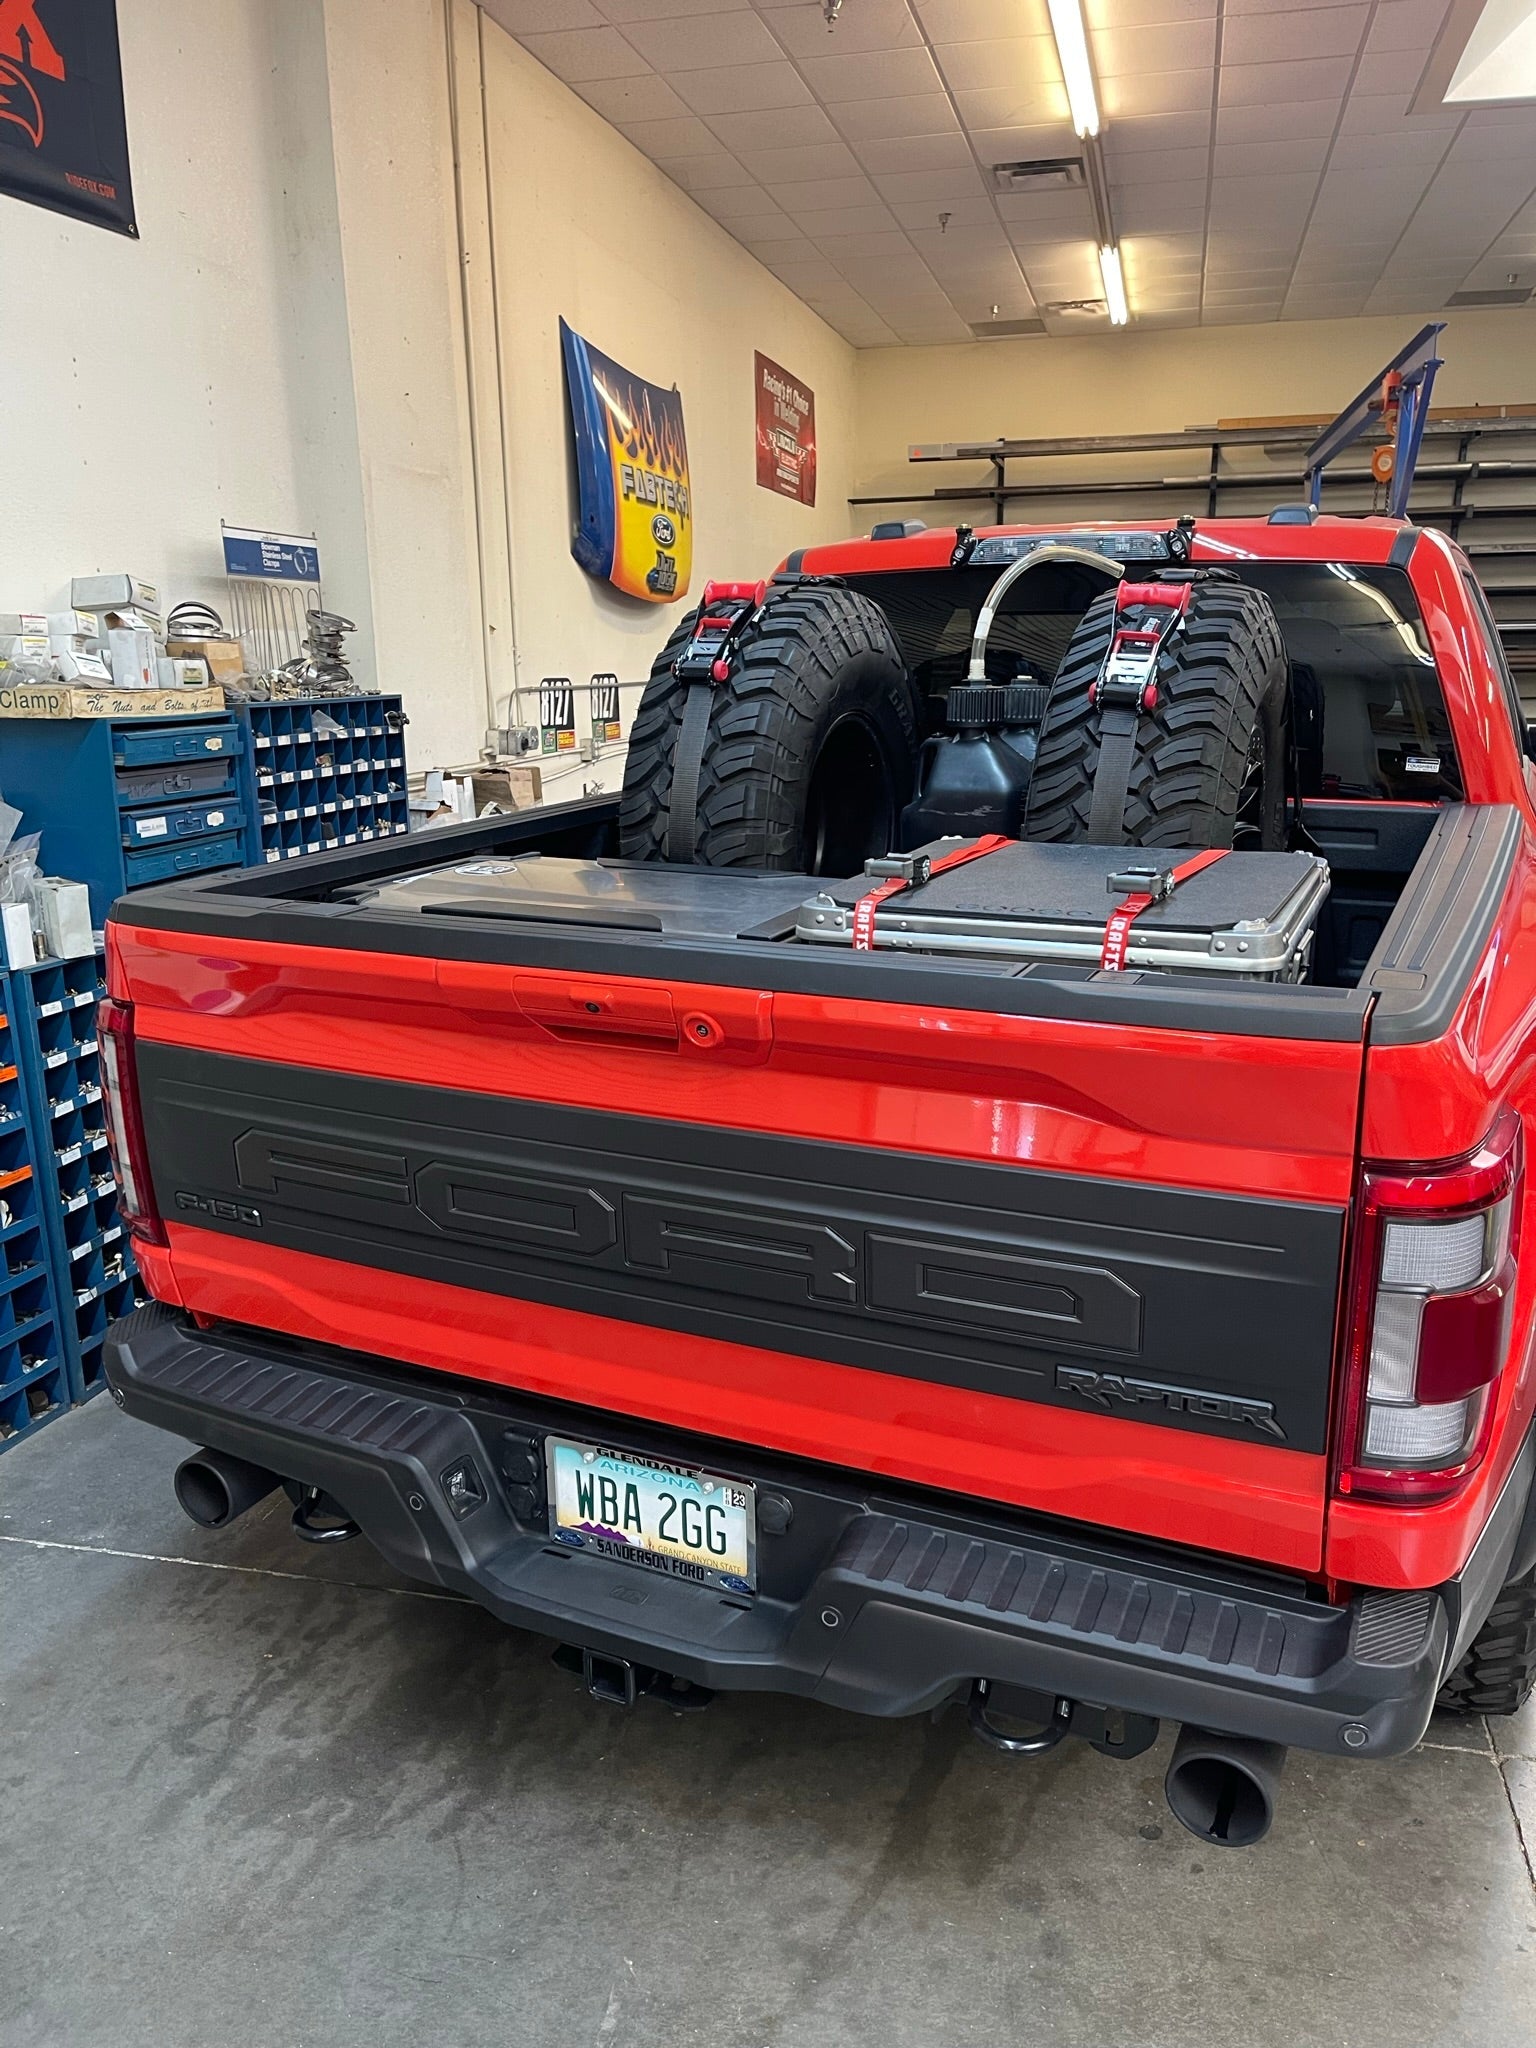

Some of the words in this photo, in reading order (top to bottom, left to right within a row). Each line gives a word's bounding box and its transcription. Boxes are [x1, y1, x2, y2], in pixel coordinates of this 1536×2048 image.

[793, 389, 809, 416] Choice
[621, 464, 689, 520] FABTECH
[656, 518, 672, 540] Ford
[262, 550, 281, 560] Stainless
[281, 552, 292, 560] Steel
[262, 558, 280, 568] Clamps
[0, 690, 59, 714] Clamp
[87, 700, 104, 713] The
[112, 700, 133, 713] Nuts
[140, 702, 157, 711] and
[164, 699, 184, 711] Bolts
[191, 699, 199, 712] of
[541, 681, 570, 726] 8127
[592, 677, 615, 720] 8127
[175, 1191, 263, 1227] F-150
[233, 1127, 1144, 1355] FORD
[1055, 1364, 1288, 1440] RAPTOR
[596, 1447, 699, 1480] GLENDALE
[600, 1459, 700, 1493] ARIZONA
[575, 1469, 643, 1534] WBA
[657, 1492, 727, 1556] 2GG
[733, 1493, 746, 1507] 23
[596, 1539, 669, 1571] SANDERSON
[672, 1560, 705, 1581] FORD
[657, 1545, 685, 1558] GRAND
[685, 1553, 719, 1569] CANYON
[719, 1563, 742, 1575] STATE
